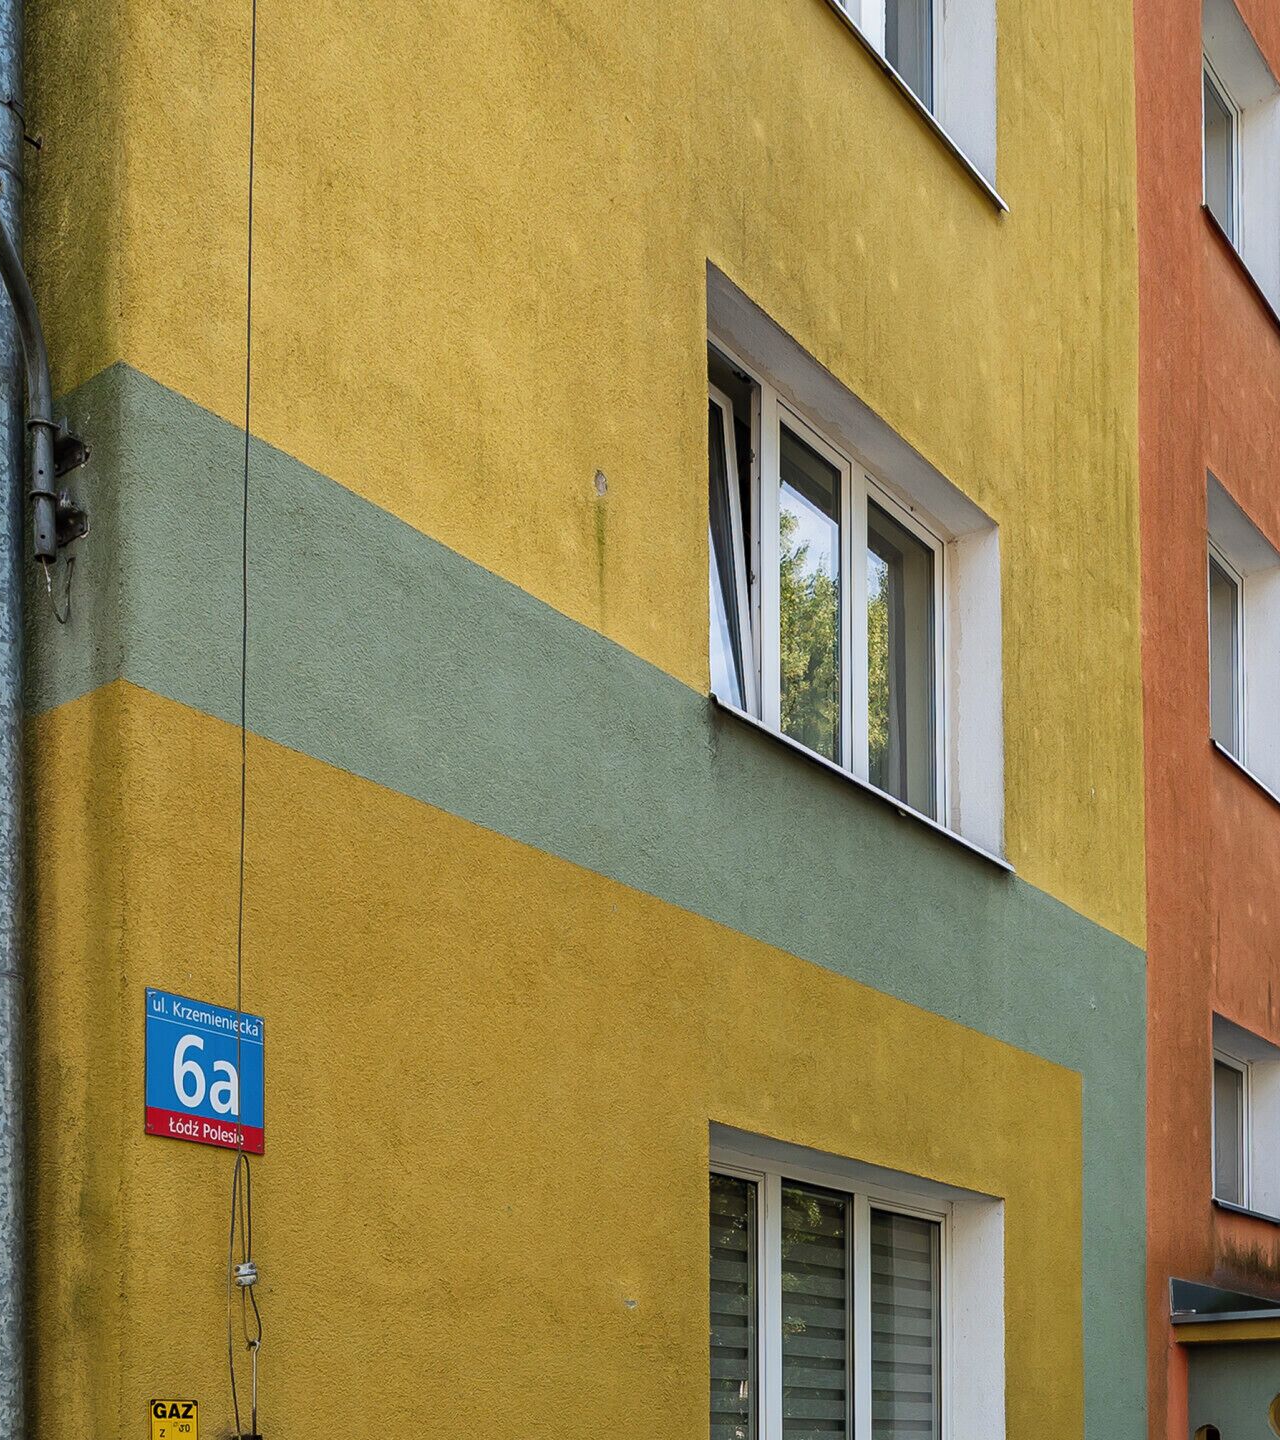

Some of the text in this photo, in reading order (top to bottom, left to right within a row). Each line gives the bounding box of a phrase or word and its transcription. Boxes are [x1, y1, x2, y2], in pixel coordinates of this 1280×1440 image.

[153, 998, 259, 1036] ul. Krzemieniecka
[173, 1034, 239, 1116] 6a
[169, 1117, 245, 1145] Łódź Polesie
[153, 1403, 193, 1419] GAZ
